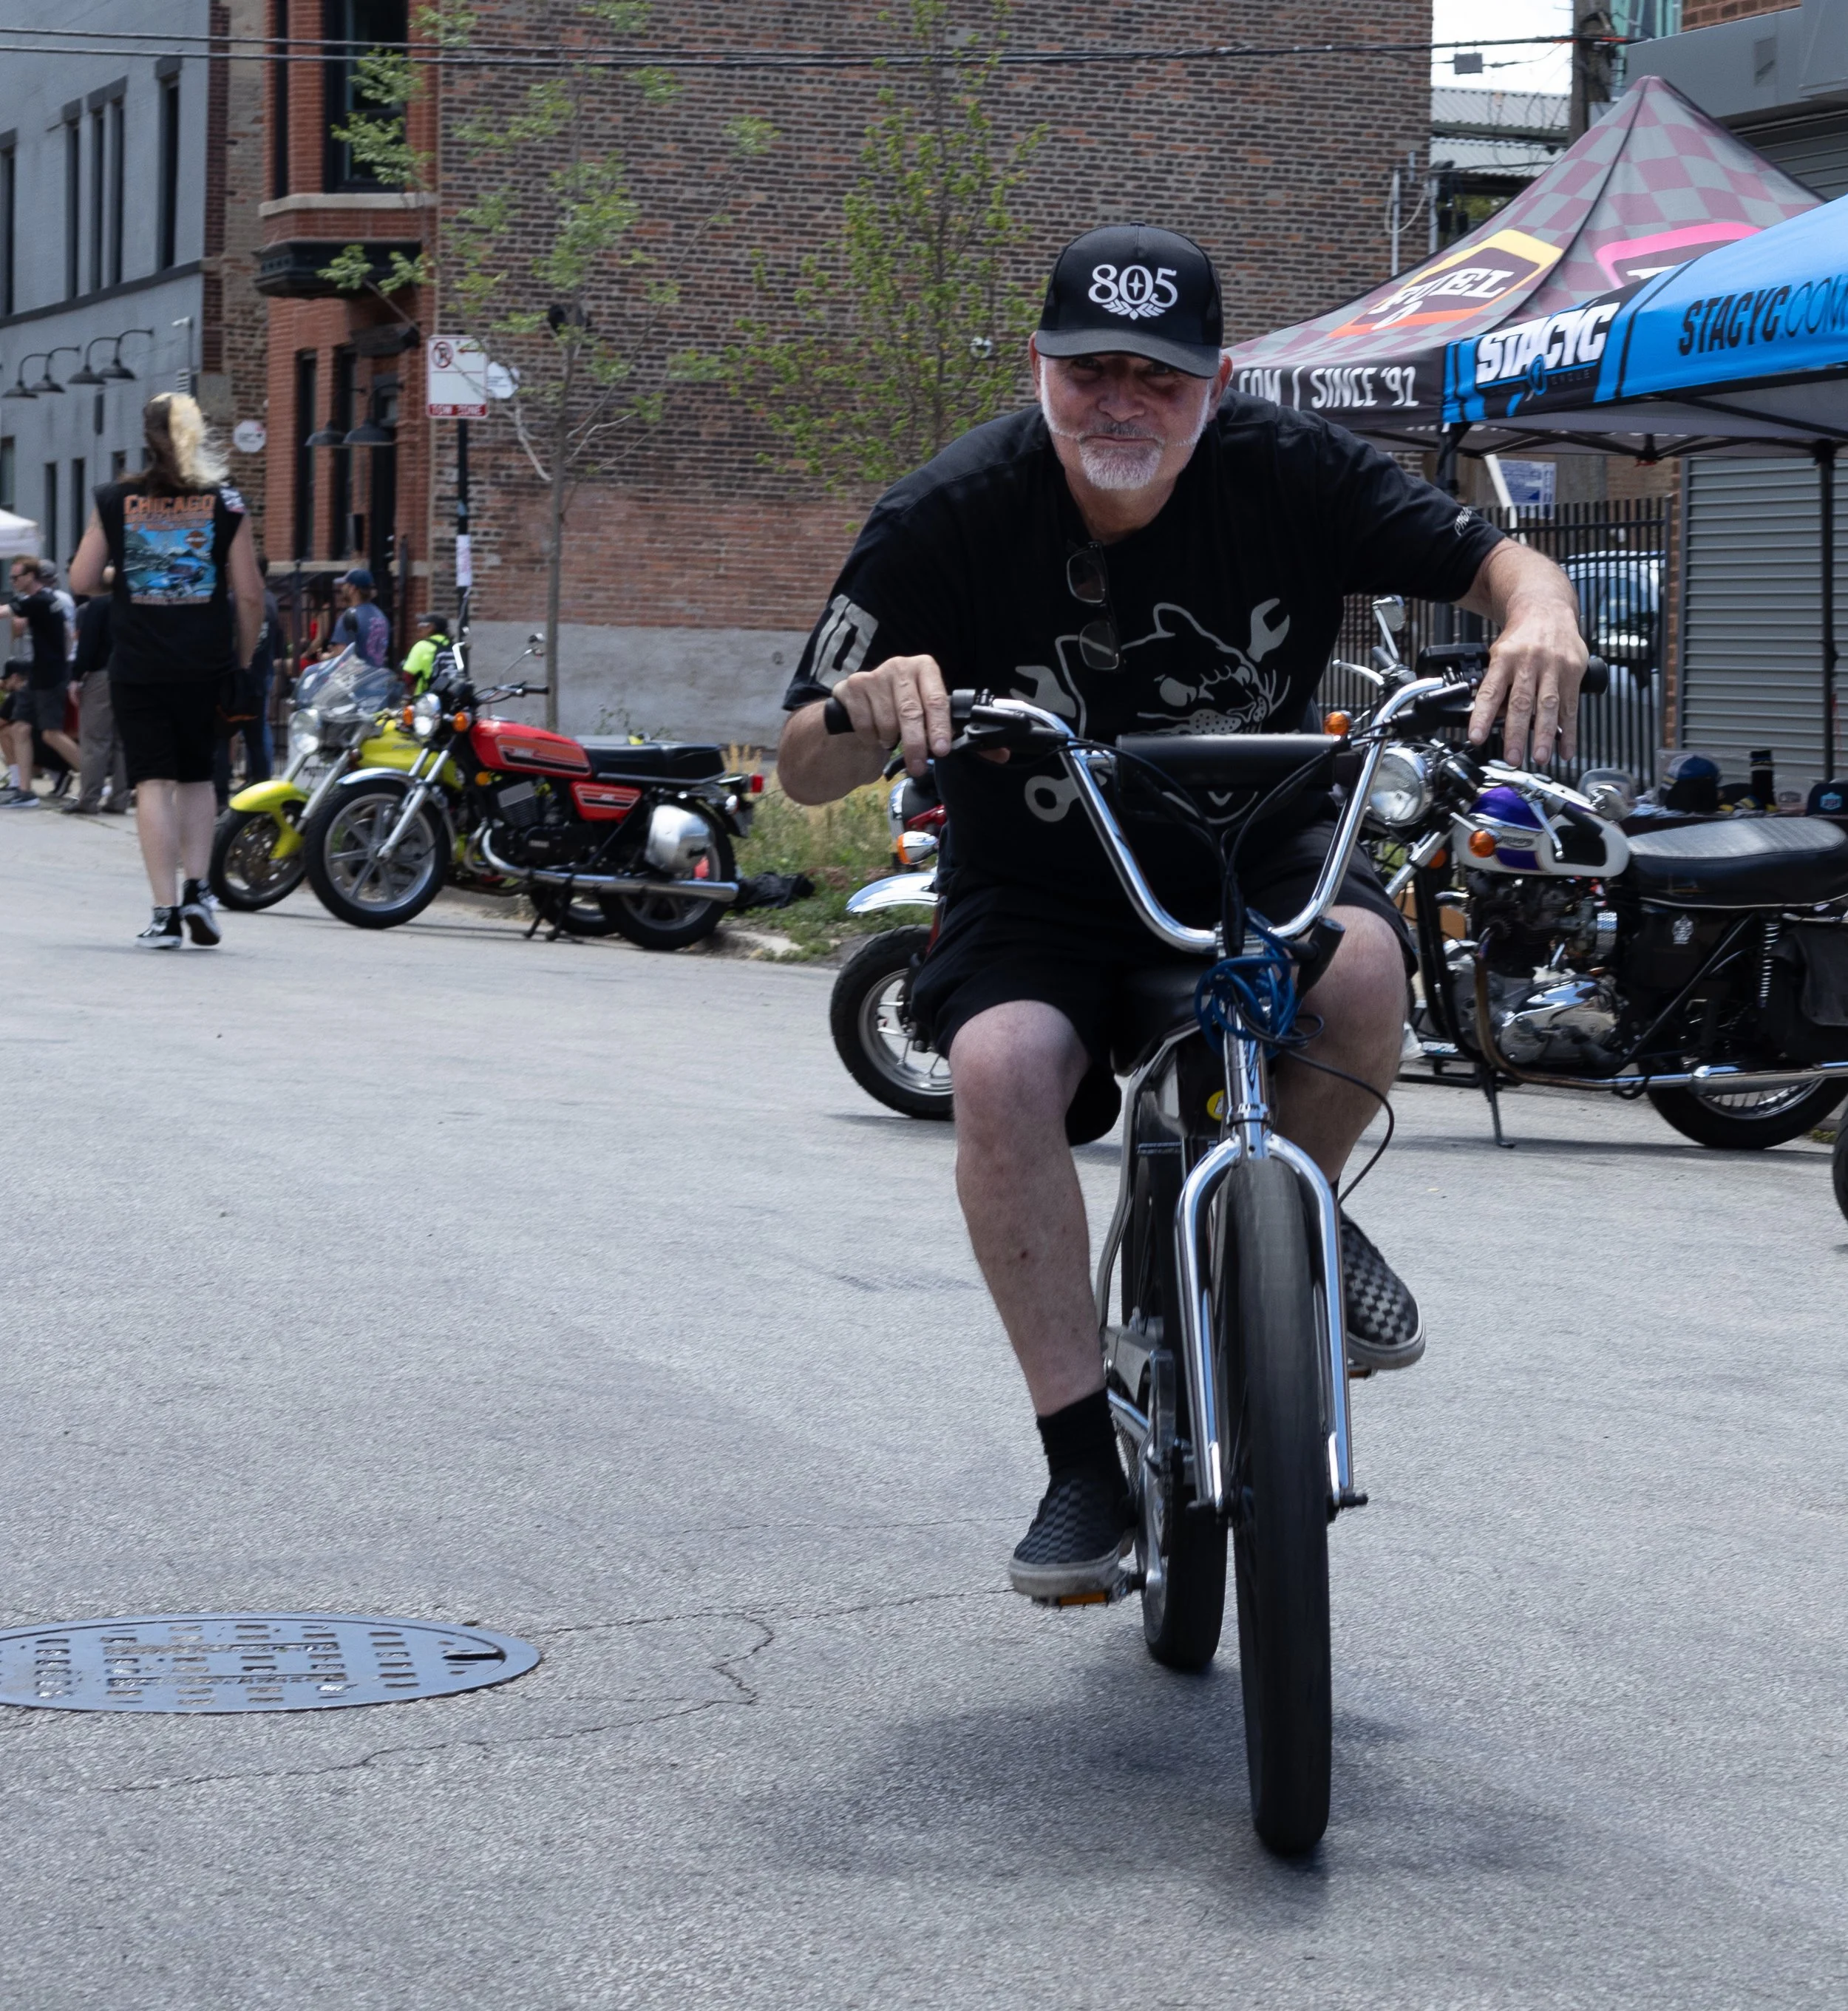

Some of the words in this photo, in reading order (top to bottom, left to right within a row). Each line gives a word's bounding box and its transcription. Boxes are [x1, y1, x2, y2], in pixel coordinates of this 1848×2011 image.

[1088, 264, 1178, 308] 805
[1368, 268, 1515, 315] FUEL
[1476, 302, 1621, 384] STACYC
[1309, 367, 1378, 409] SINCE
[124, 494, 216, 514] CHICAGO
[809, 594, 880, 690] 10
